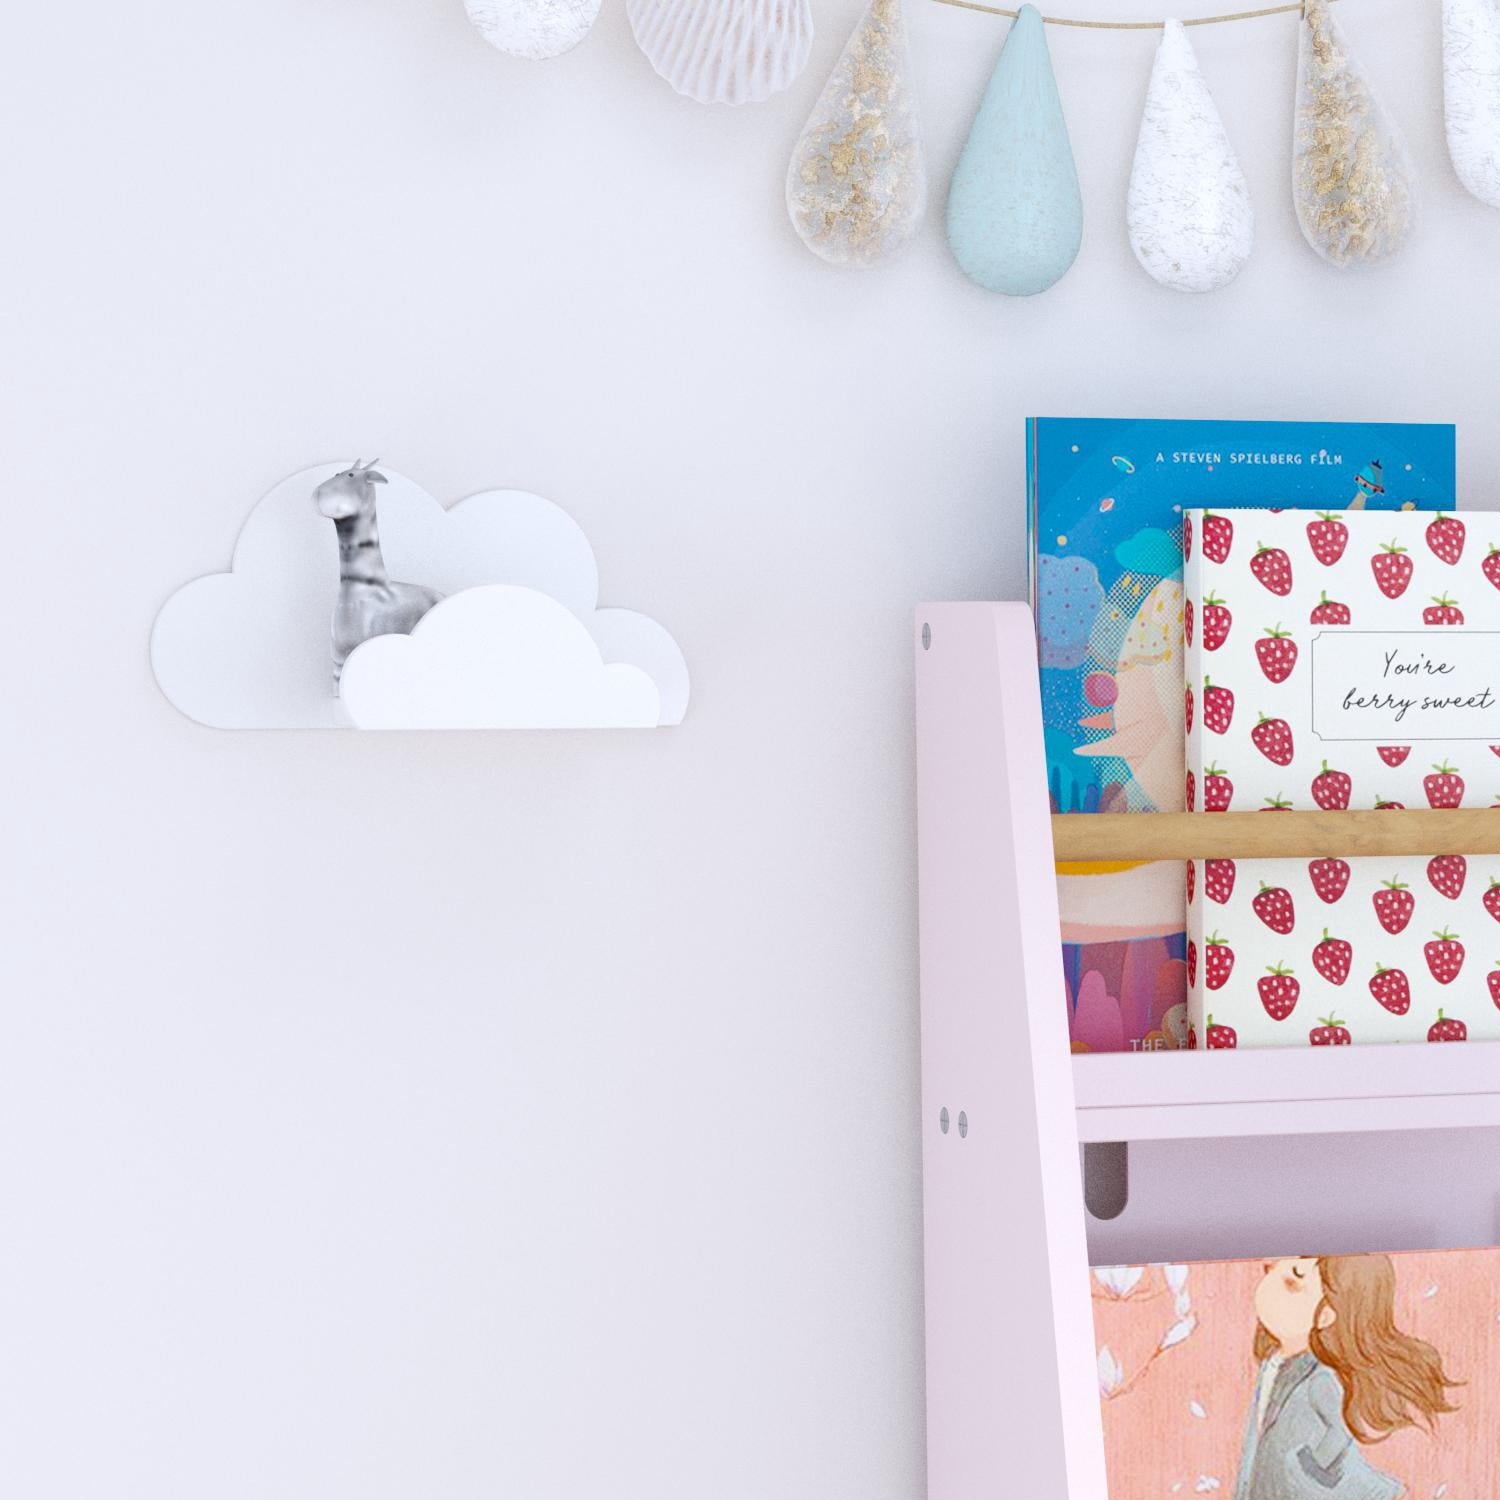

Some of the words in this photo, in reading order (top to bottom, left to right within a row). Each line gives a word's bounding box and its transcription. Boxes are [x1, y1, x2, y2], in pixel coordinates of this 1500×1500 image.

[1155, 452, 1165, 464] A
[1172, 451, 1222, 464] STEVEN
[1229, 452, 1303, 465] SPIELBERG
[1310, 452, 1343, 466] FILM
[1382, 648, 1456, 678] You're
[1342, 687, 1418, 722] berry
[1420, 687, 1496, 710] sweet
[1129, 1038, 1163, 1052] THE
